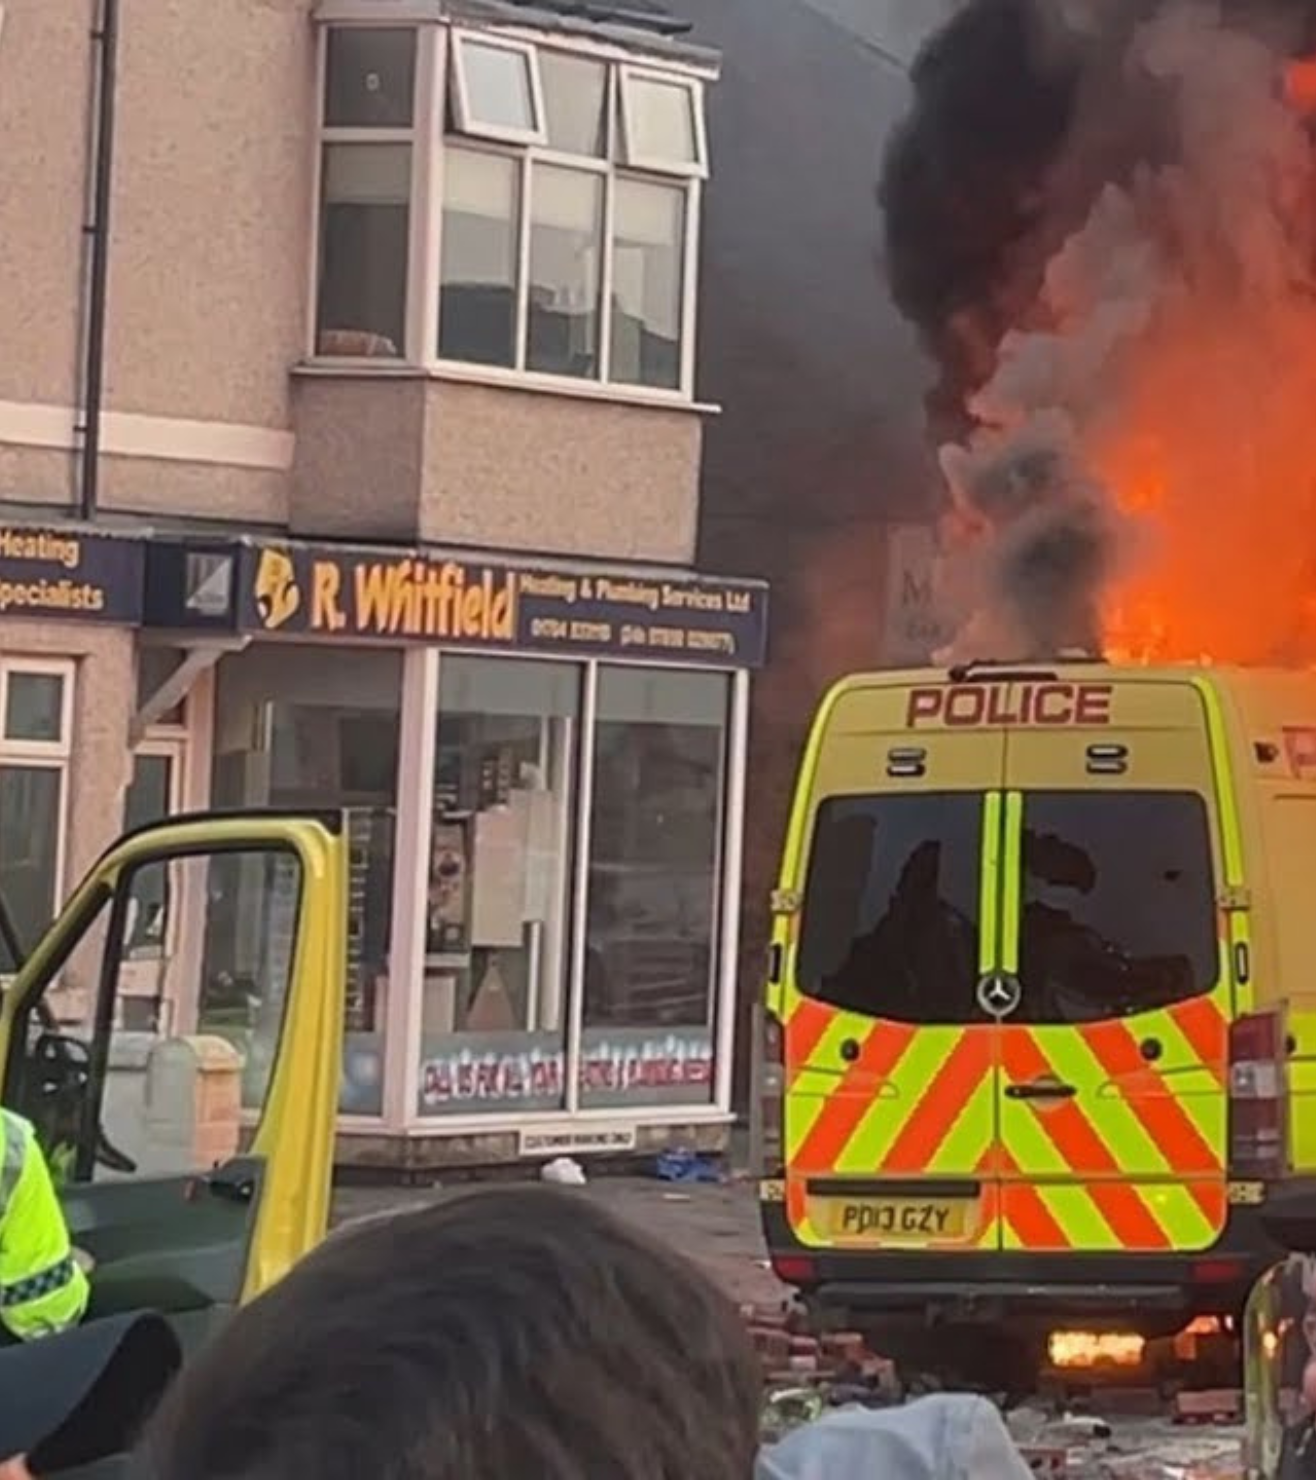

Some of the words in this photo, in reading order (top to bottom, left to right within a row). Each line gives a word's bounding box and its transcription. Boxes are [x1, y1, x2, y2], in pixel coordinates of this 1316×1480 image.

[0, 579, 104, 610] pecialists
[311, 560, 346, 630] R.
[354, 559, 516, 640] Whitfield
[520, 574, 577, 603] Heating
[580, 578, 593, 599] &
[596, 579, 659, 610] Plumbing
[662, 585, 722, 611] Services
[725, 590, 751, 613] Ltd
[906, 685, 1113, 729] POLICE
[901, 1203, 950, 1232] GZY
